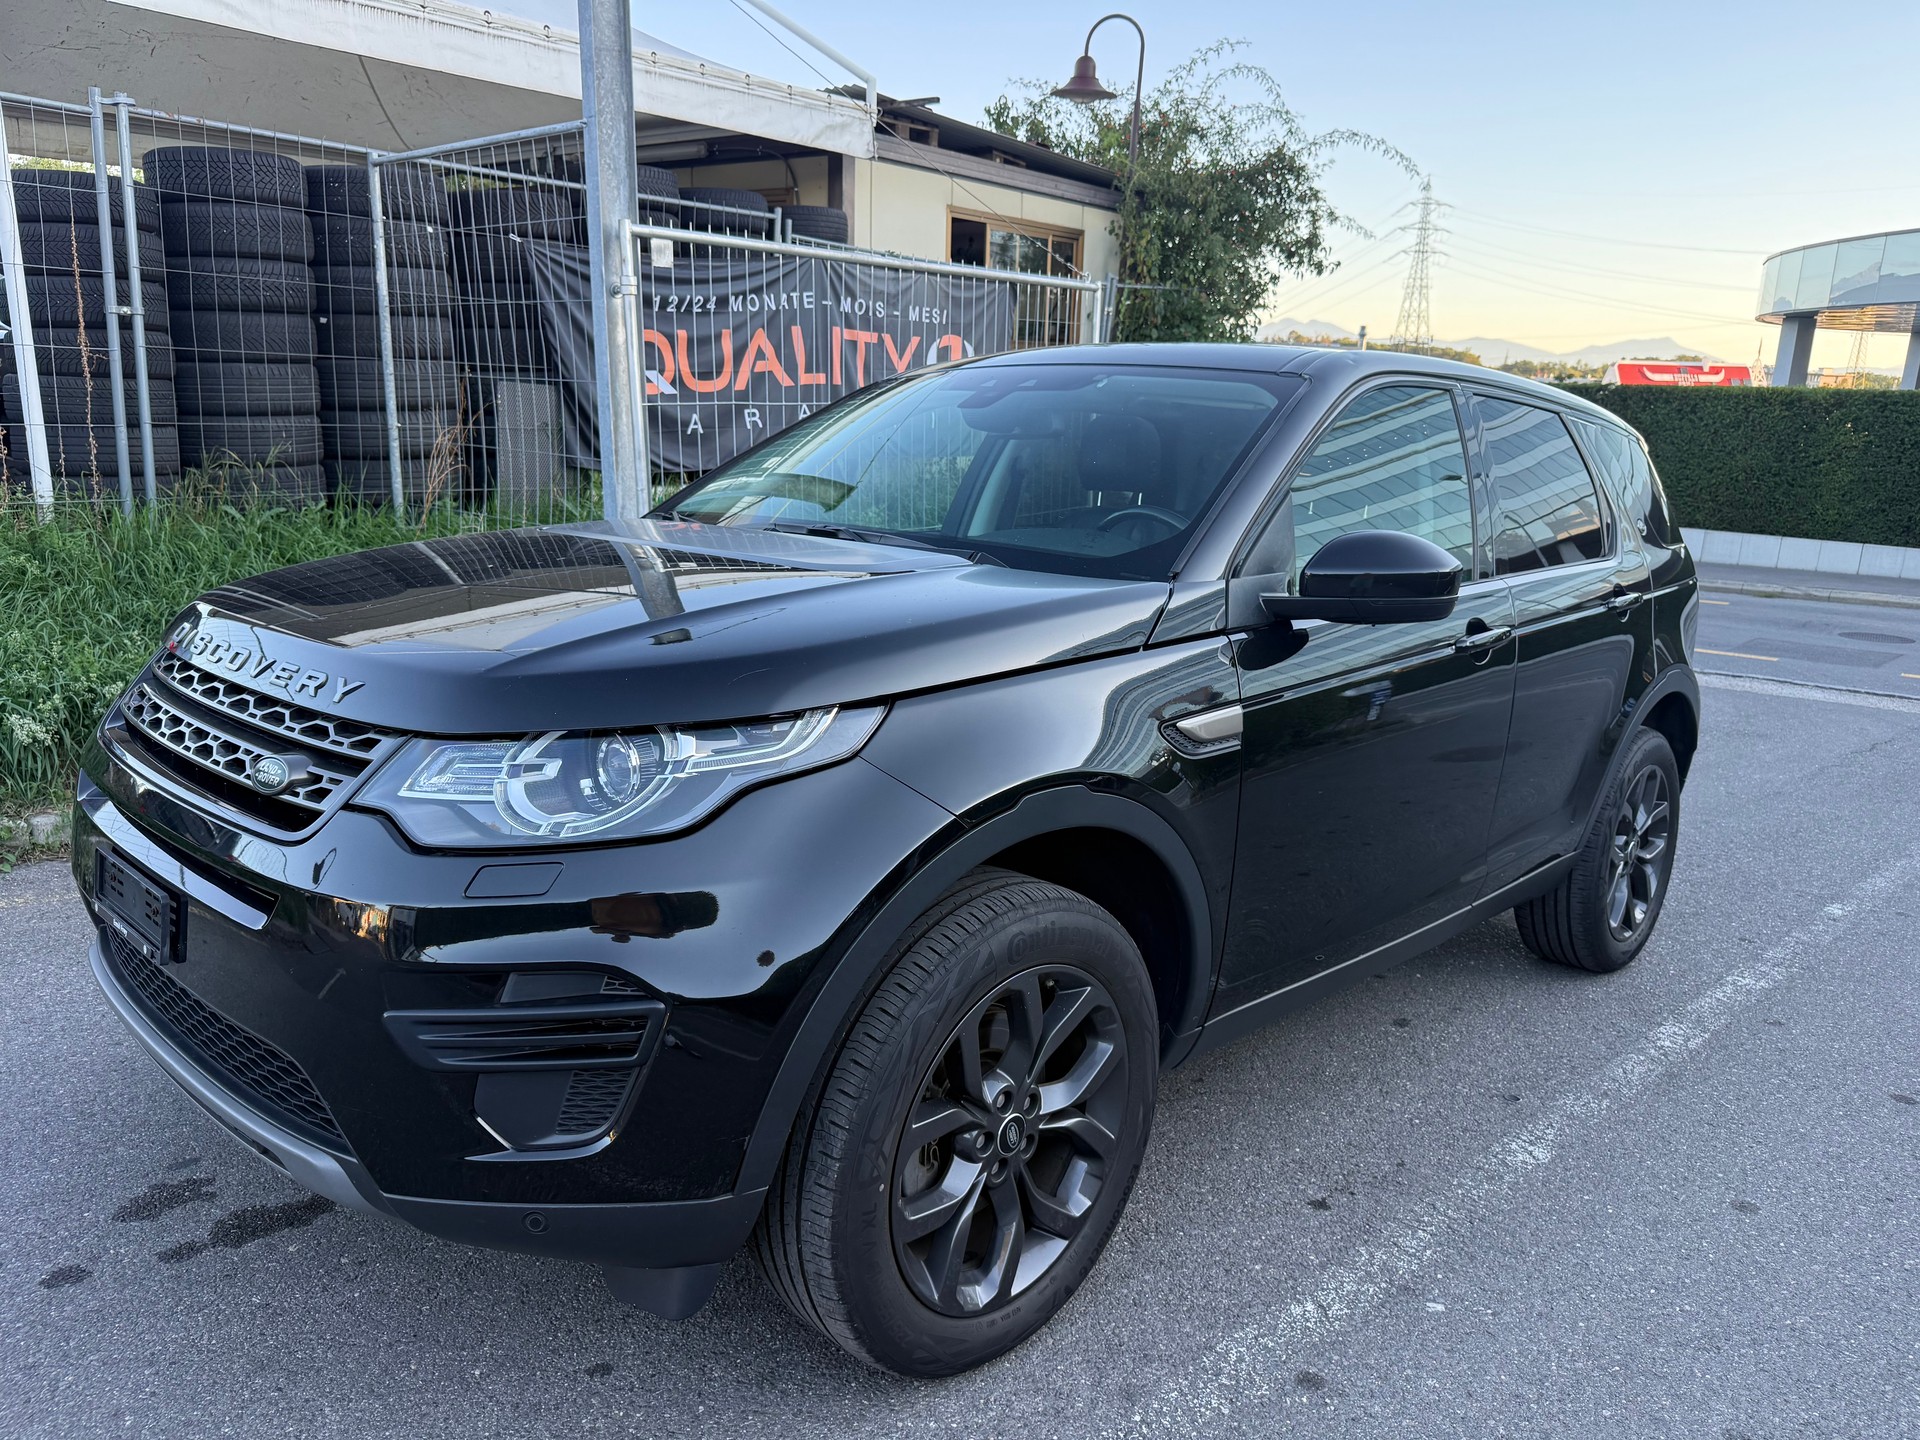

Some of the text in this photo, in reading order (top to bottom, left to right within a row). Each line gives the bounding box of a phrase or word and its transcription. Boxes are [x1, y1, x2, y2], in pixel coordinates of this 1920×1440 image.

[654, 294, 717, 313] 12/24
[729, 291, 815, 312] MONATE
[840, 296, 885, 318] MOIS
[908, 305, 948, 325] MESI
[172, 622, 366, 704] DISCOVERY
[257, 771, 280, 787] ROVER
[259, 761, 279, 775] LAND
